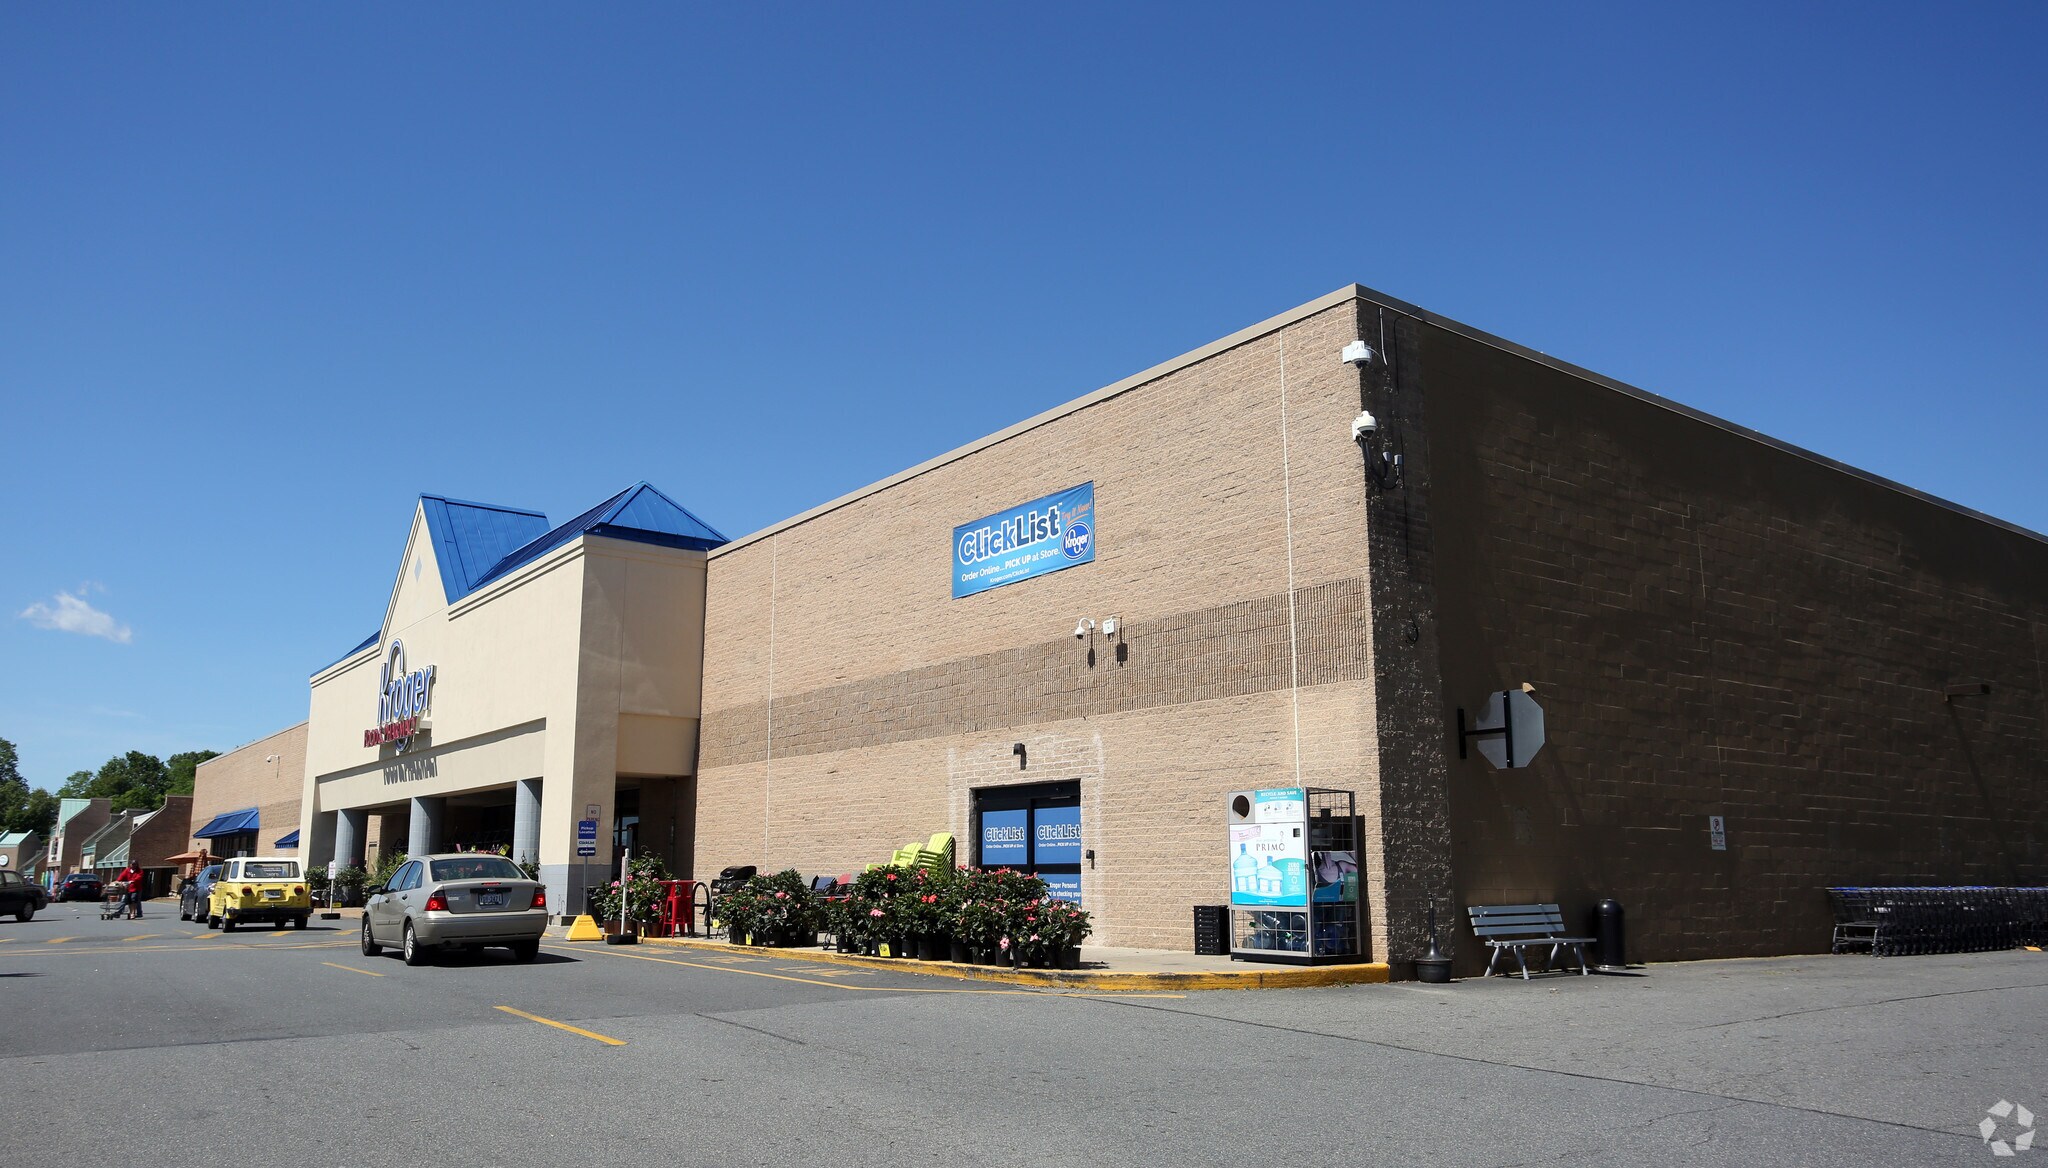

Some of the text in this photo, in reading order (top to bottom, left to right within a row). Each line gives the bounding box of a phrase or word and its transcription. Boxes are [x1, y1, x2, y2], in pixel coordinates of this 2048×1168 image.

[959, 507, 1061, 565] ClickList
[1065, 529, 1089, 554] Kroger
[961, 570, 979, 582] Order
[1021, 555, 1032, 565] UP
[1031, 553, 1040, 562] at
[377, 638, 437, 752] Kroger
[985, 827, 1025, 842] ClickList
[1037, 824, 1081, 840] ClickList
